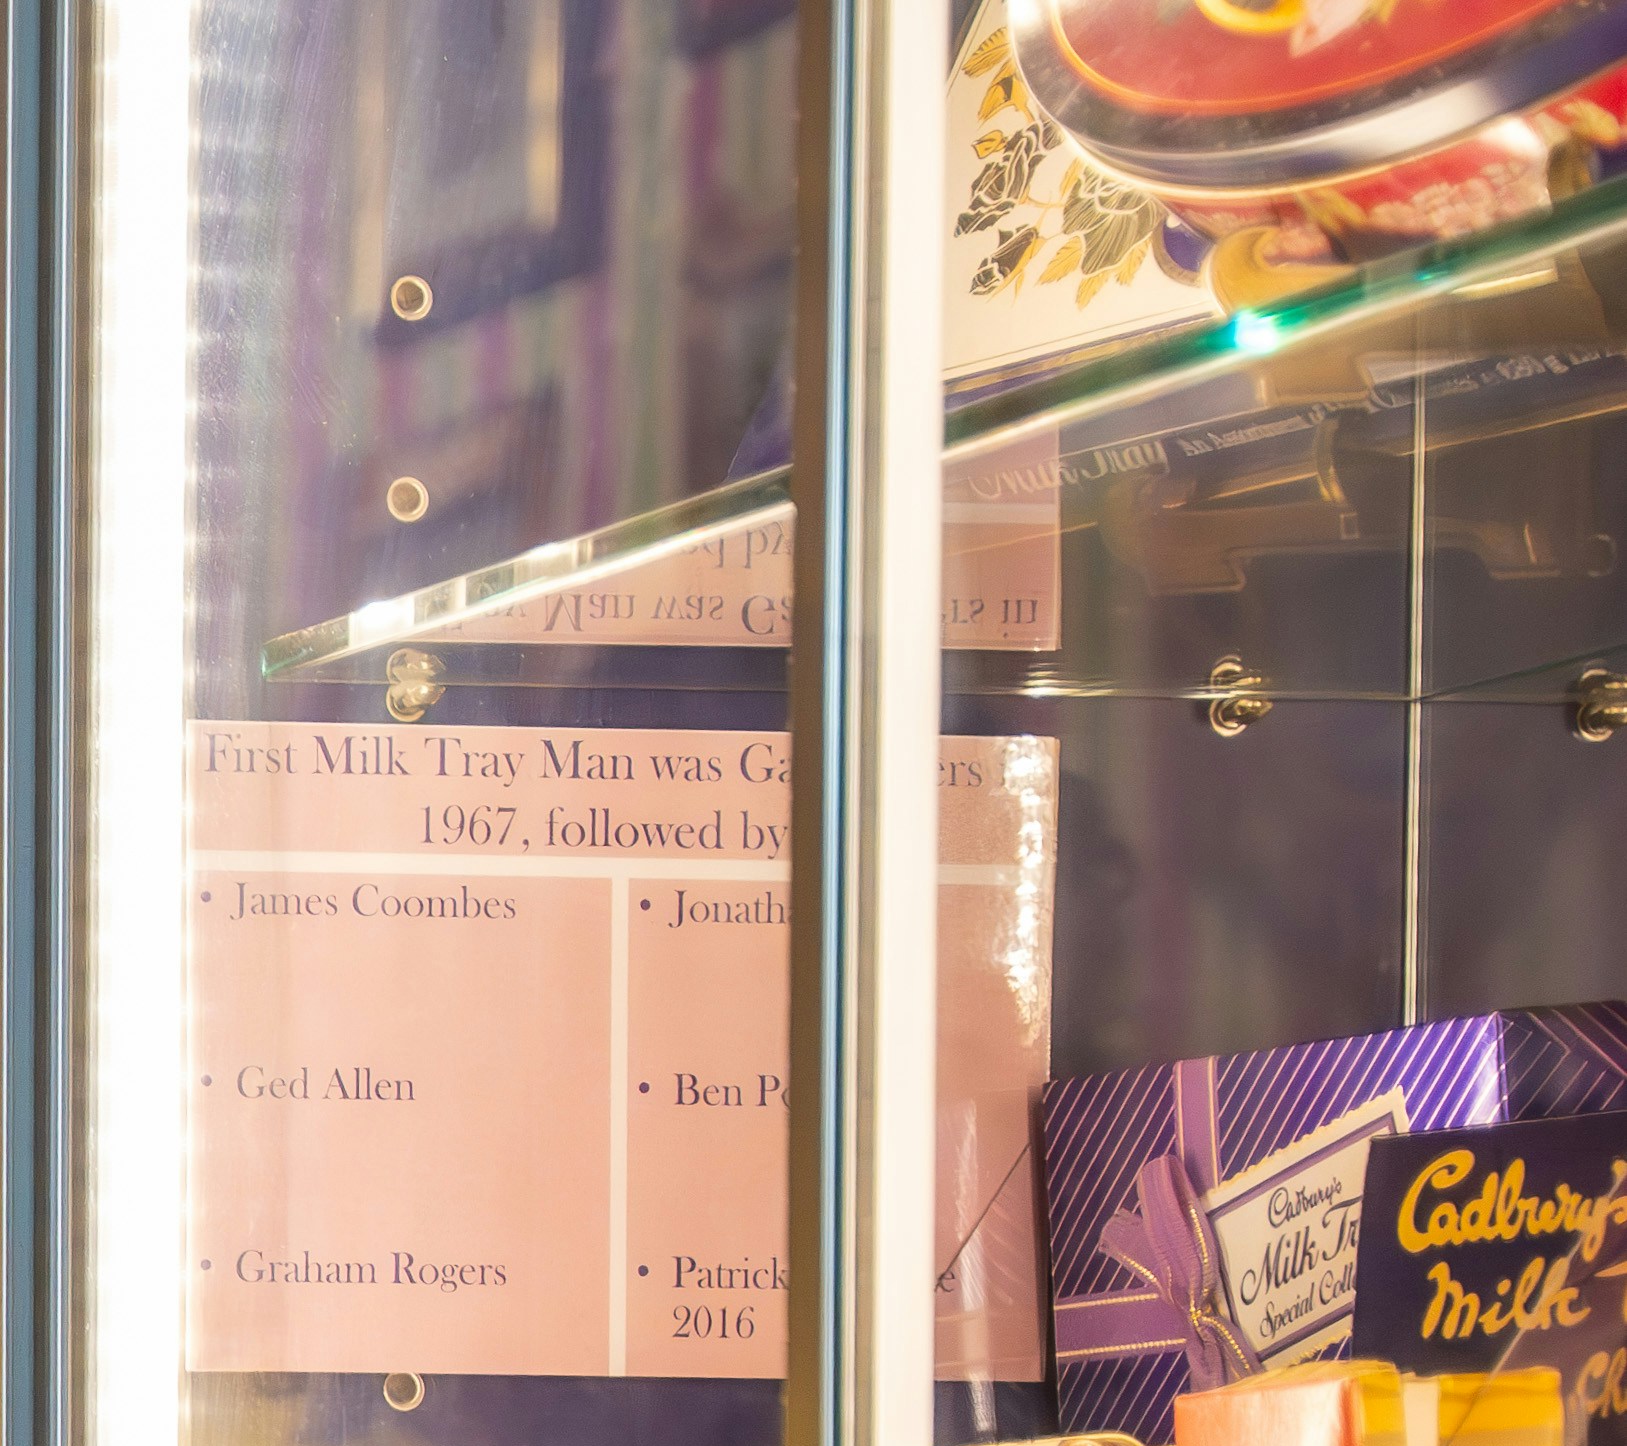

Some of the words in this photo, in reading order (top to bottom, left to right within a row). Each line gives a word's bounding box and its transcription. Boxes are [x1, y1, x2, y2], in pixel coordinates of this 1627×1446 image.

[204, 733, 297, 776] First
[312, 735, 411, 776] Milk
[424, 737, 526, 787] Tray
[540, 740, 635, 782] Man
[650, 753, 723, 783] was
[421, 804, 530, 852] 1967,
[546, 806, 724, 850] followed
[739, 810, 790, 859] by
[229, 881, 339, 922] James
[352, 883, 517, 920] Coombes
[236, 1065, 311, 1101] Ged
[321, 1065, 416, 1102] Allen
[673, 1072, 744, 1108] Ben
[1267, 1177, 1343, 1229] Cadbury's
[235, 1249, 378, 1285] Graham
[391, 1251, 508, 1293] Rogers
[671, 1256, 791, 1290] Patrick
[1240, 1226, 1321, 1306] Milk
[1322, 1194, 1364, 1262] Tr
[672, 1305, 755, 1339] 2016
[1260, 1282, 1316, 1340] Special
[1422, 1257, 1593, 1340] Milk
